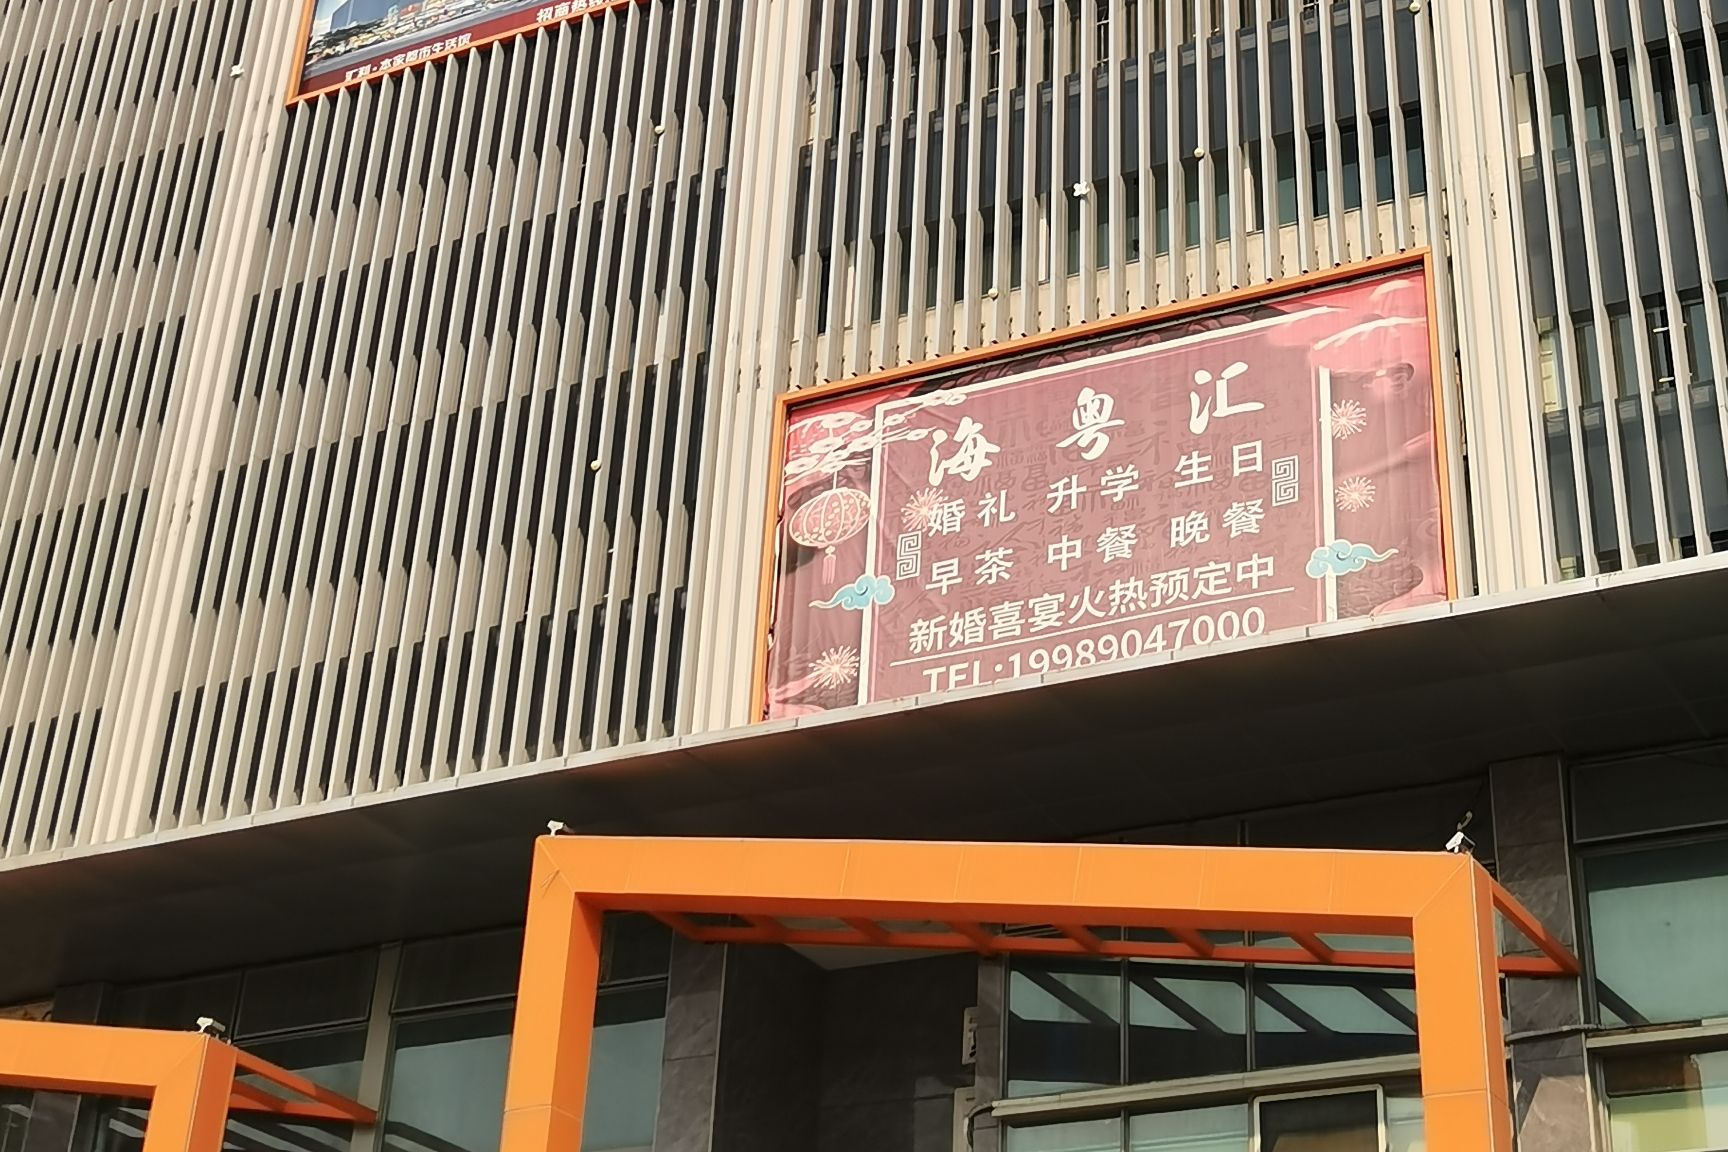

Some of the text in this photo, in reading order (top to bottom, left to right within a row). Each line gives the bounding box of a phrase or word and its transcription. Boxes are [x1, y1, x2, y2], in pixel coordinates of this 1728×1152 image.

[928, 361, 1264, 486] 海粤汇
[929, 440, 1262, 537] 婚礼 升学 生日
[926, 499, 1264, 595] 早茶 中餐 晚餐
[909, 554, 1274, 654] 新婚喜宴火热预定中
